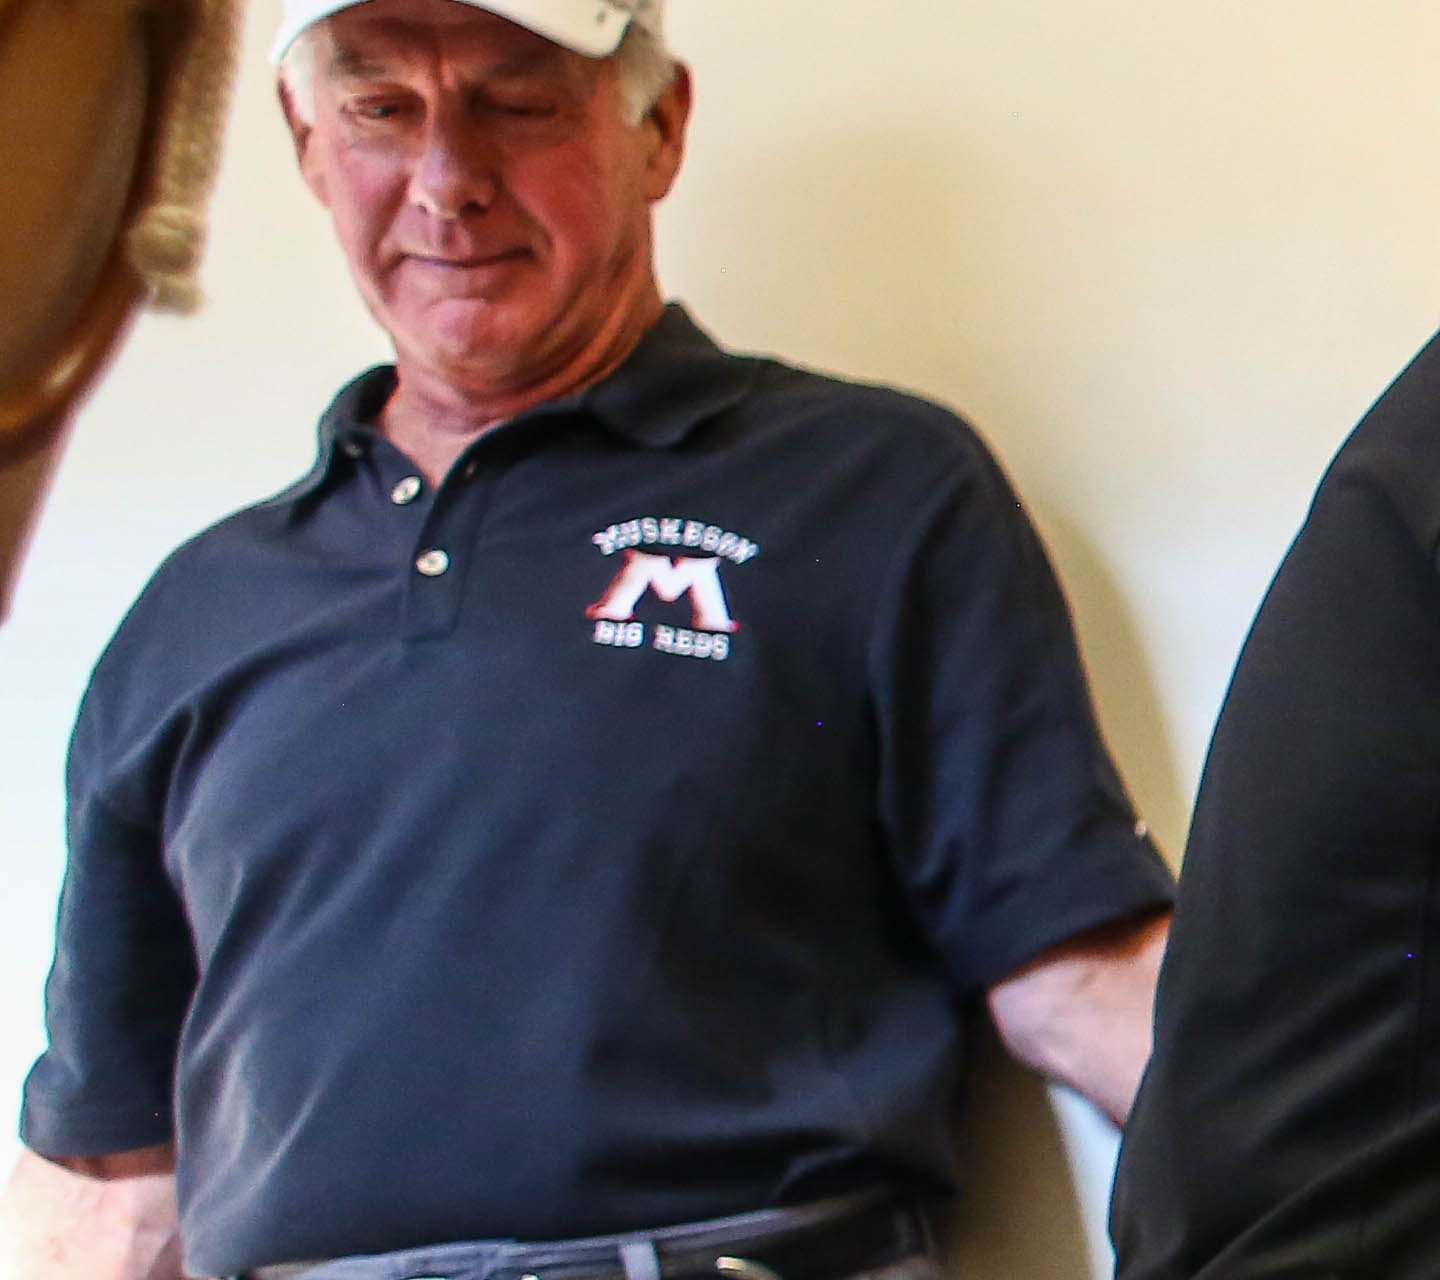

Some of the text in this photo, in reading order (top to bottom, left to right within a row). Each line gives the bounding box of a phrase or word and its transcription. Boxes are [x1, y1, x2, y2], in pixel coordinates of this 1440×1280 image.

[591, 517, 760, 566] MUSKEGON
[584, 548, 741, 632] M
[592, 620, 730, 661] BIG REDS
